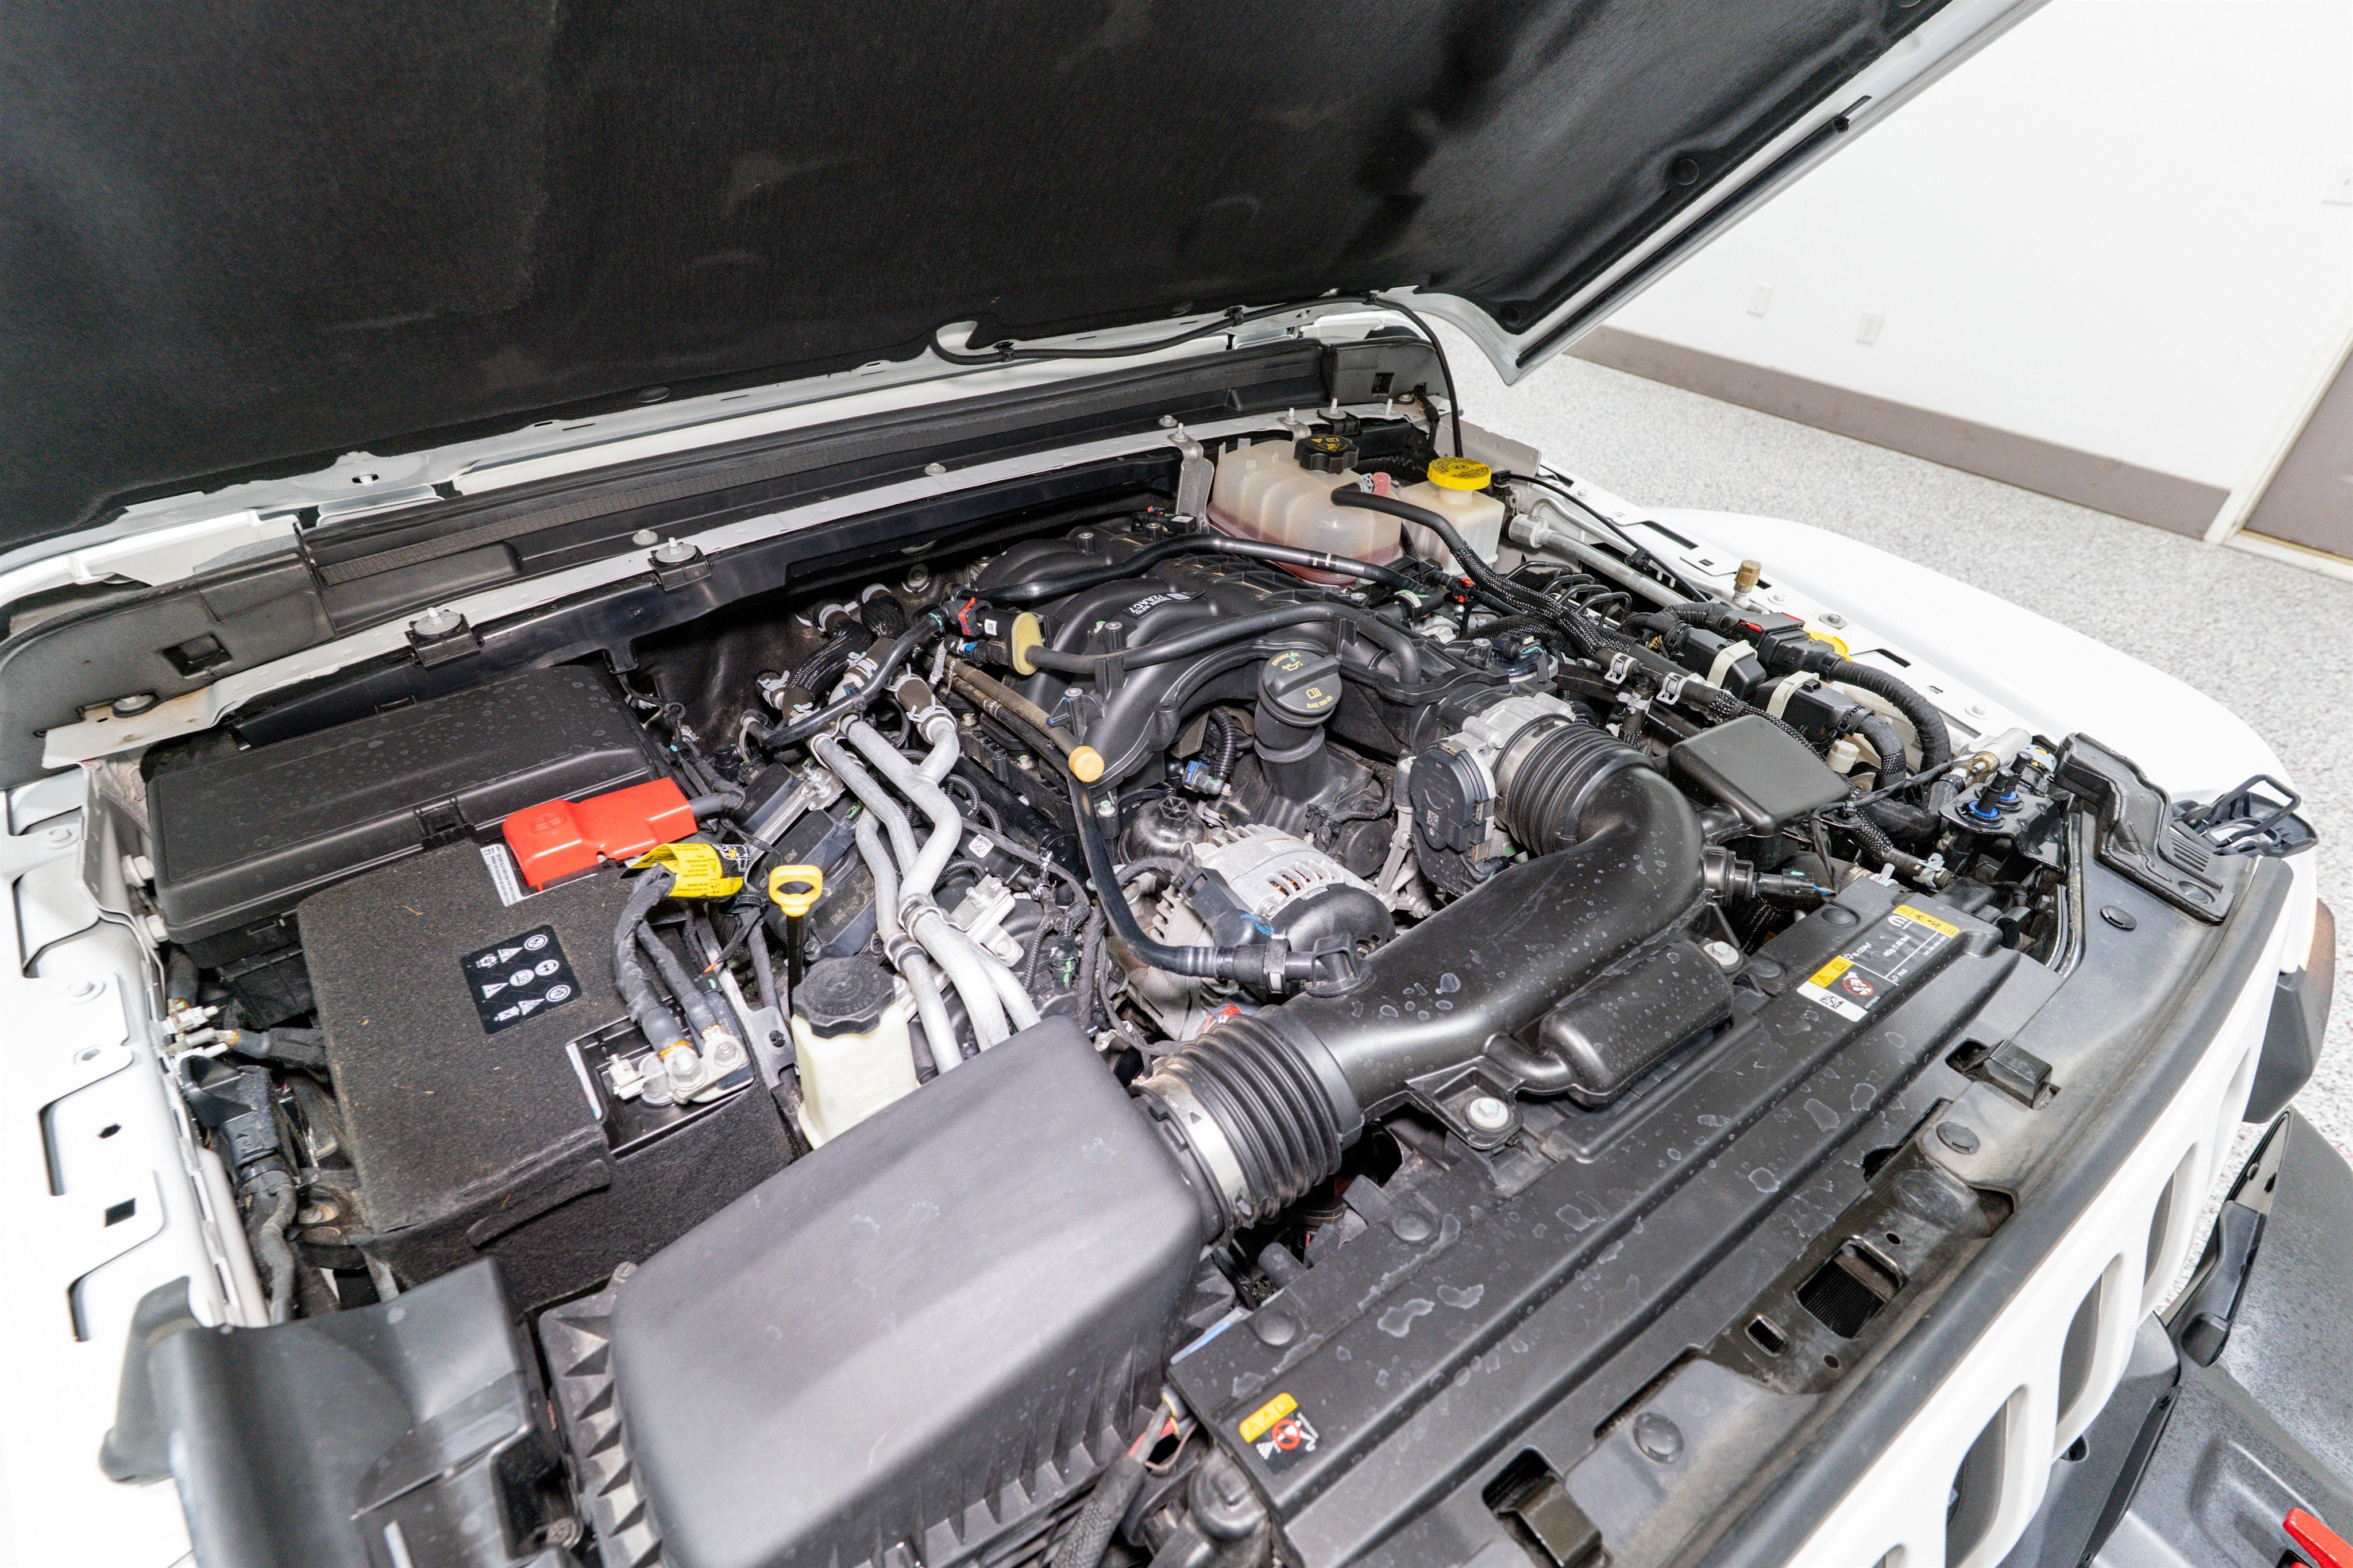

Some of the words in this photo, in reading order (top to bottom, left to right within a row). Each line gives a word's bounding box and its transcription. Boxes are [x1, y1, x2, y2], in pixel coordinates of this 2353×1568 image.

[1129, 594, 1165, 613] 72AAC7
[1150, 596, 1172, 606] ENGINE
[1136, 605, 1151, 615] RFID
[1271, 653, 1290, 666] ENGINE
[1318, 695, 1333, 706] 0W-20
[1897, 968, 1908, 977] PAG
